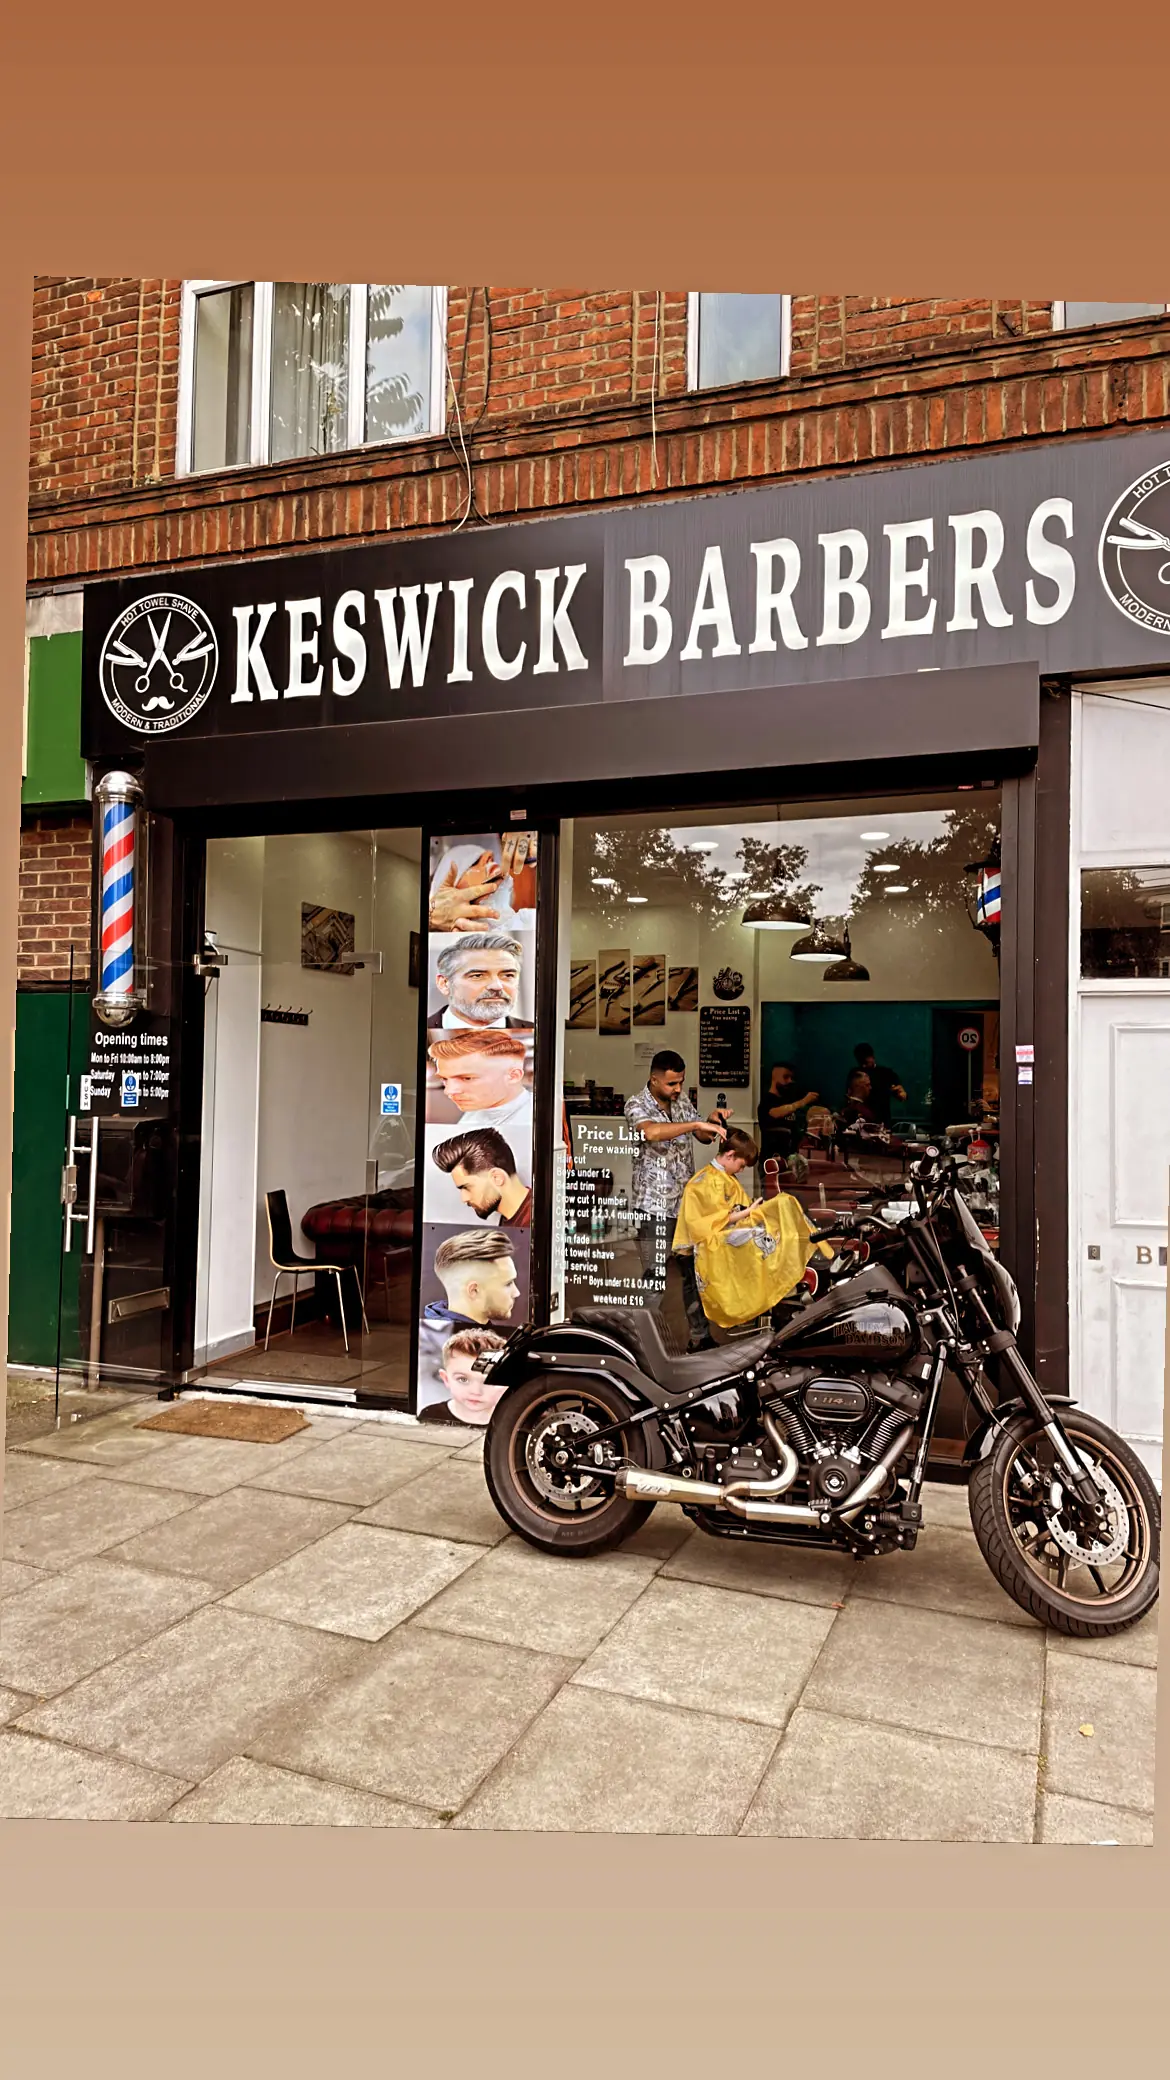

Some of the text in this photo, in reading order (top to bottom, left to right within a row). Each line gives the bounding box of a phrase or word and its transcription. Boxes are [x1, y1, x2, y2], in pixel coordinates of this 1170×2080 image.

[1132, 472, 1161, 499] HOT
[230, 497, 1077, 704] KESWICK BARBERS
[120, 597, 199, 627] HOT TOWEL SHAVE
[1119, 593, 1170, 631] MODERN
[111, 692, 205, 730] MODERN & TRADITIONAL
[94, 1031, 168, 1048] Opening times
[90, 1052, 103, 1063] Mon
[104, 1053, 110, 1064] to
[111, 1053, 119, 1064] Fri
[143, 1054, 150, 1064] to
[90, 1068, 115, 1082] Saturday
[142, 1070, 149, 1081] to
[90, 1085, 112, 1098] Sunday
[142, 1087, 149, 1097] to
[577, 1125, 646, 1141] Price List
[583, 1144, 640, 1157] Free waxing
[574, 1155, 586, 1164] cut
[556, 1167, 575, 1178] Boys
[577, 1168, 599, 1178] under
[601, 1169, 610, 1178] 12
[580, 1181, 595, 1191] trim
[577, 1195, 590, 1205] cut
[591, 1195, 596, 1205] 1
[597, 1196, 627, 1206] number
[577, 1208, 590, 1218] cut
[617, 1210, 651, 1221] numbers
[655, 1225, 667, 1236] £12
[573, 1234, 590, 1245] fade
[655, 1240, 667, 1250] £20
[555, 1246, 666, 1263] Hot towel shave £21
[1136, 1245, 1153, 1264] B
[570, 1262, 598, 1272] service
[655, 1266, 666, 1277] £40
[573, 1274, 582, 1284] Fri
[588, 1275, 604, 1288] Boys
[604, 1278, 621, 1287] under
[622, 1278, 630, 1288] 12
[654, 1280, 666, 1291] £14
[593, 1294, 644, 1306] weekend £16
[845, 1331, 906, 1346] DAVIDSON
